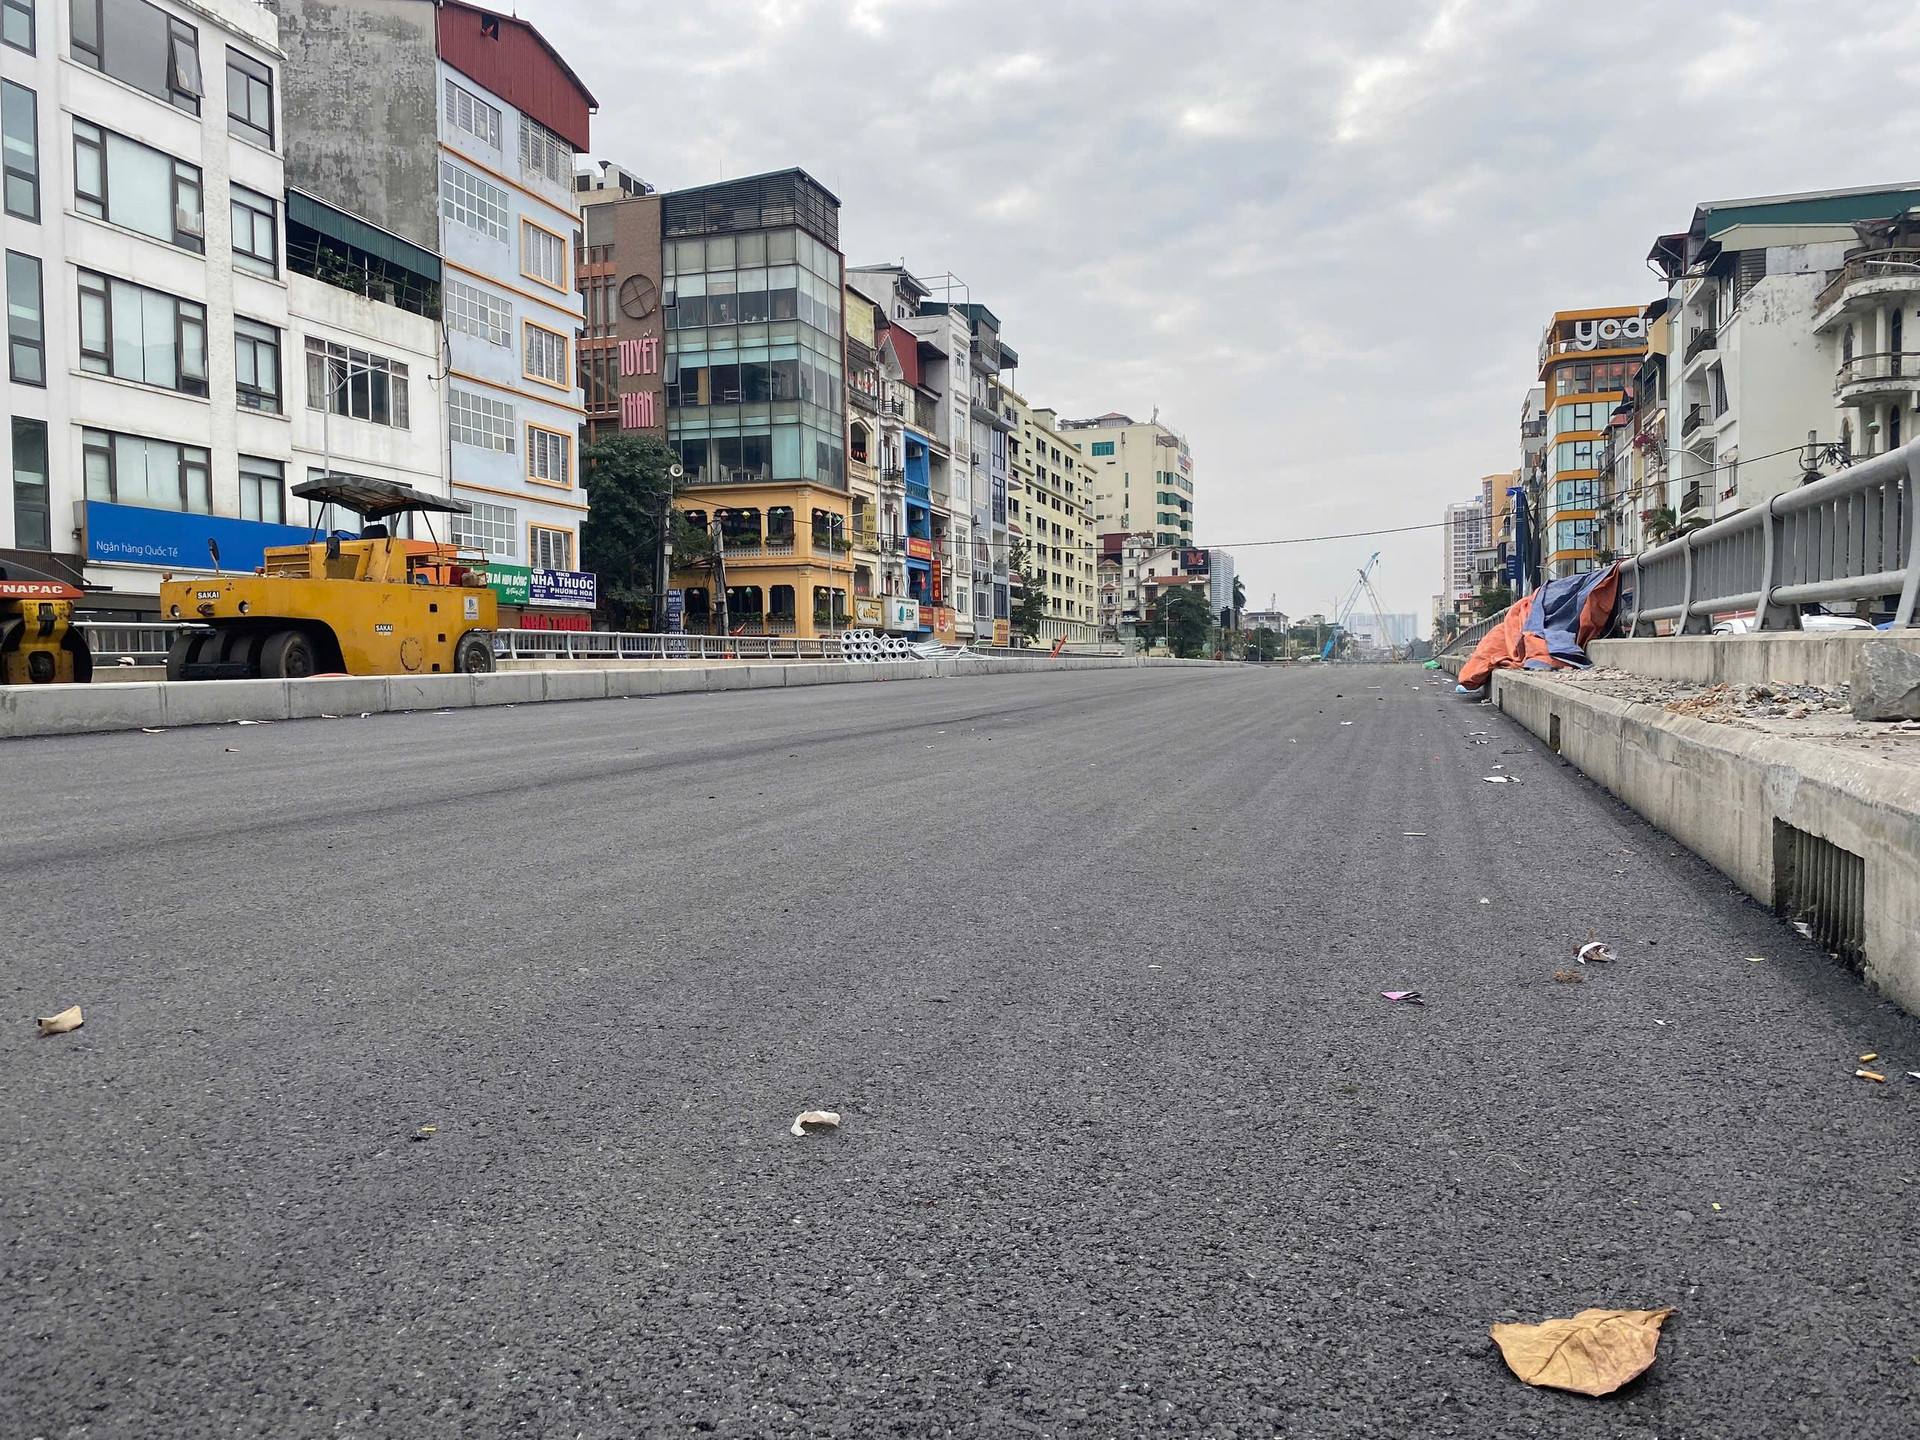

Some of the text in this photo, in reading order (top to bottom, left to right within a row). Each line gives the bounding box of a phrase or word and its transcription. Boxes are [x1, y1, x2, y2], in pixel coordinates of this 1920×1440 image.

[618, 329, 659, 376] TUYẾT
[619, 391, 655, 429] THAN
[96, 541, 178, 557] Ngân hàng Quốc Tế
[531, 573, 594, 590] NHÀ THUỐC
[197, 591, 220, 599] SAKAI
[550, 587, 578, 596] PHƯƠNG
[375, 624, 393, 632] SAKAI
[521, 614, 591, 632] NHÀ THUỐC
